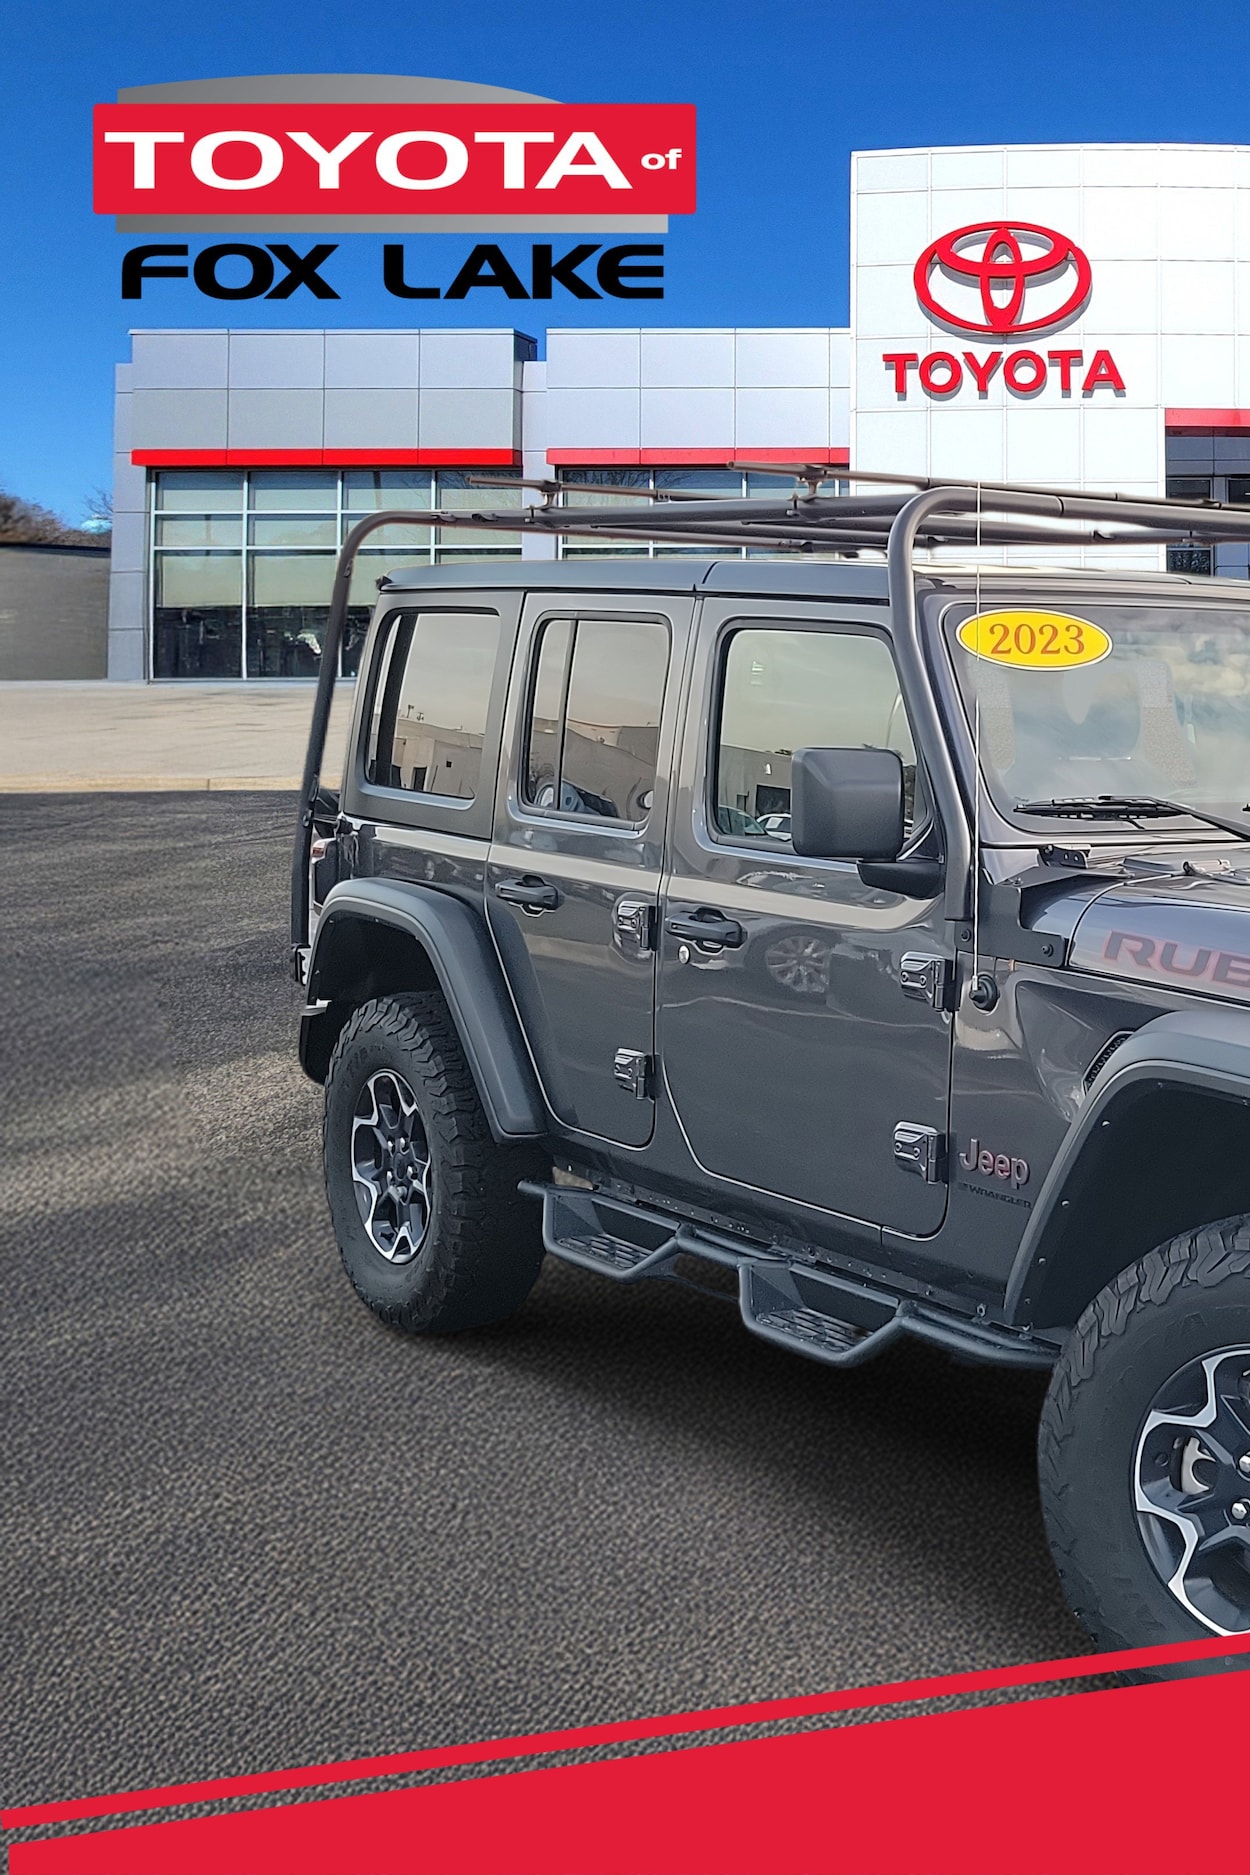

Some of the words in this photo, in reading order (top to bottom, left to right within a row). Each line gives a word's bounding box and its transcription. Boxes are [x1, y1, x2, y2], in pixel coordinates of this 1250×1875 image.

[882, 350, 1127, 398] TOYOTA
[989, 623, 1085, 655] 2023
[959, 1138, 1030, 1190] Jeep
